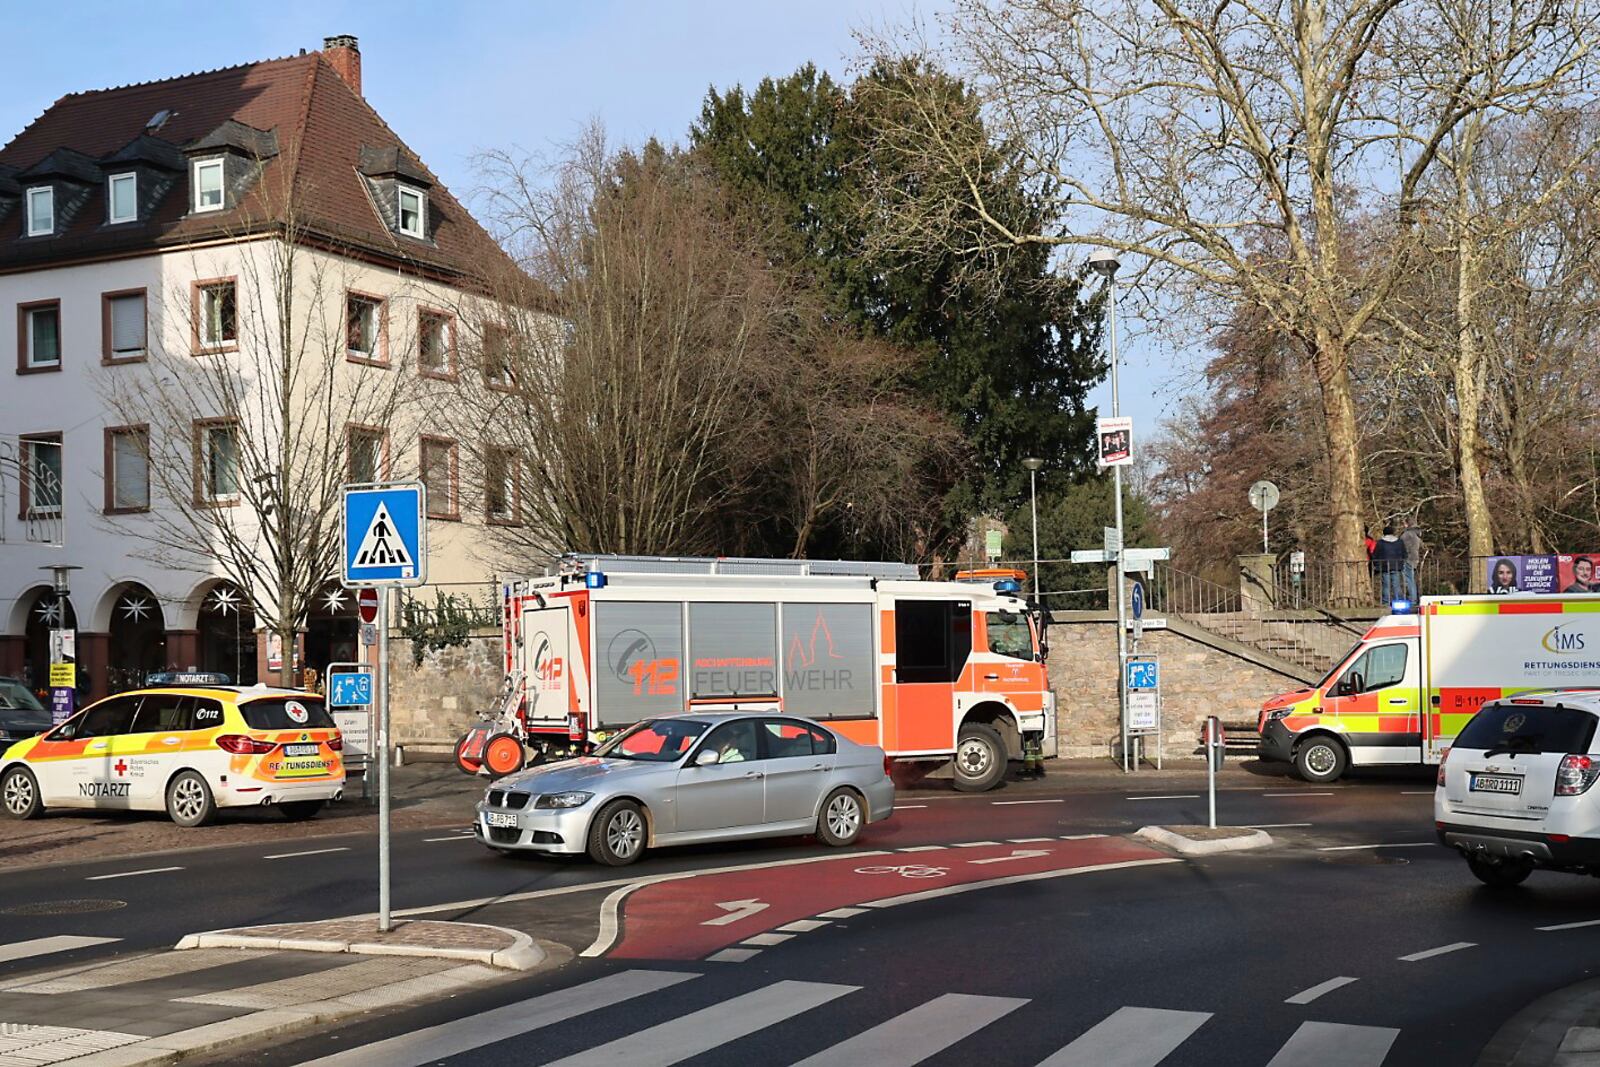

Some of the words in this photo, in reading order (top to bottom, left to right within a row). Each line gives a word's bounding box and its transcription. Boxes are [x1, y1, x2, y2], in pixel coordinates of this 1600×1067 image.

[179, 674, 209, 683] NOTARZT
[628, 658, 679, 696] 112
[1467, 695, 1487, 707] 112
[205, 710, 219, 719] 112
[269, 760, 334, 771] RETUNGSDIENST
[78, 782, 132, 797] NOTARZT
[1475, 778, 1485, 789] AB
[1499, 780, 1518, 792] 1111
